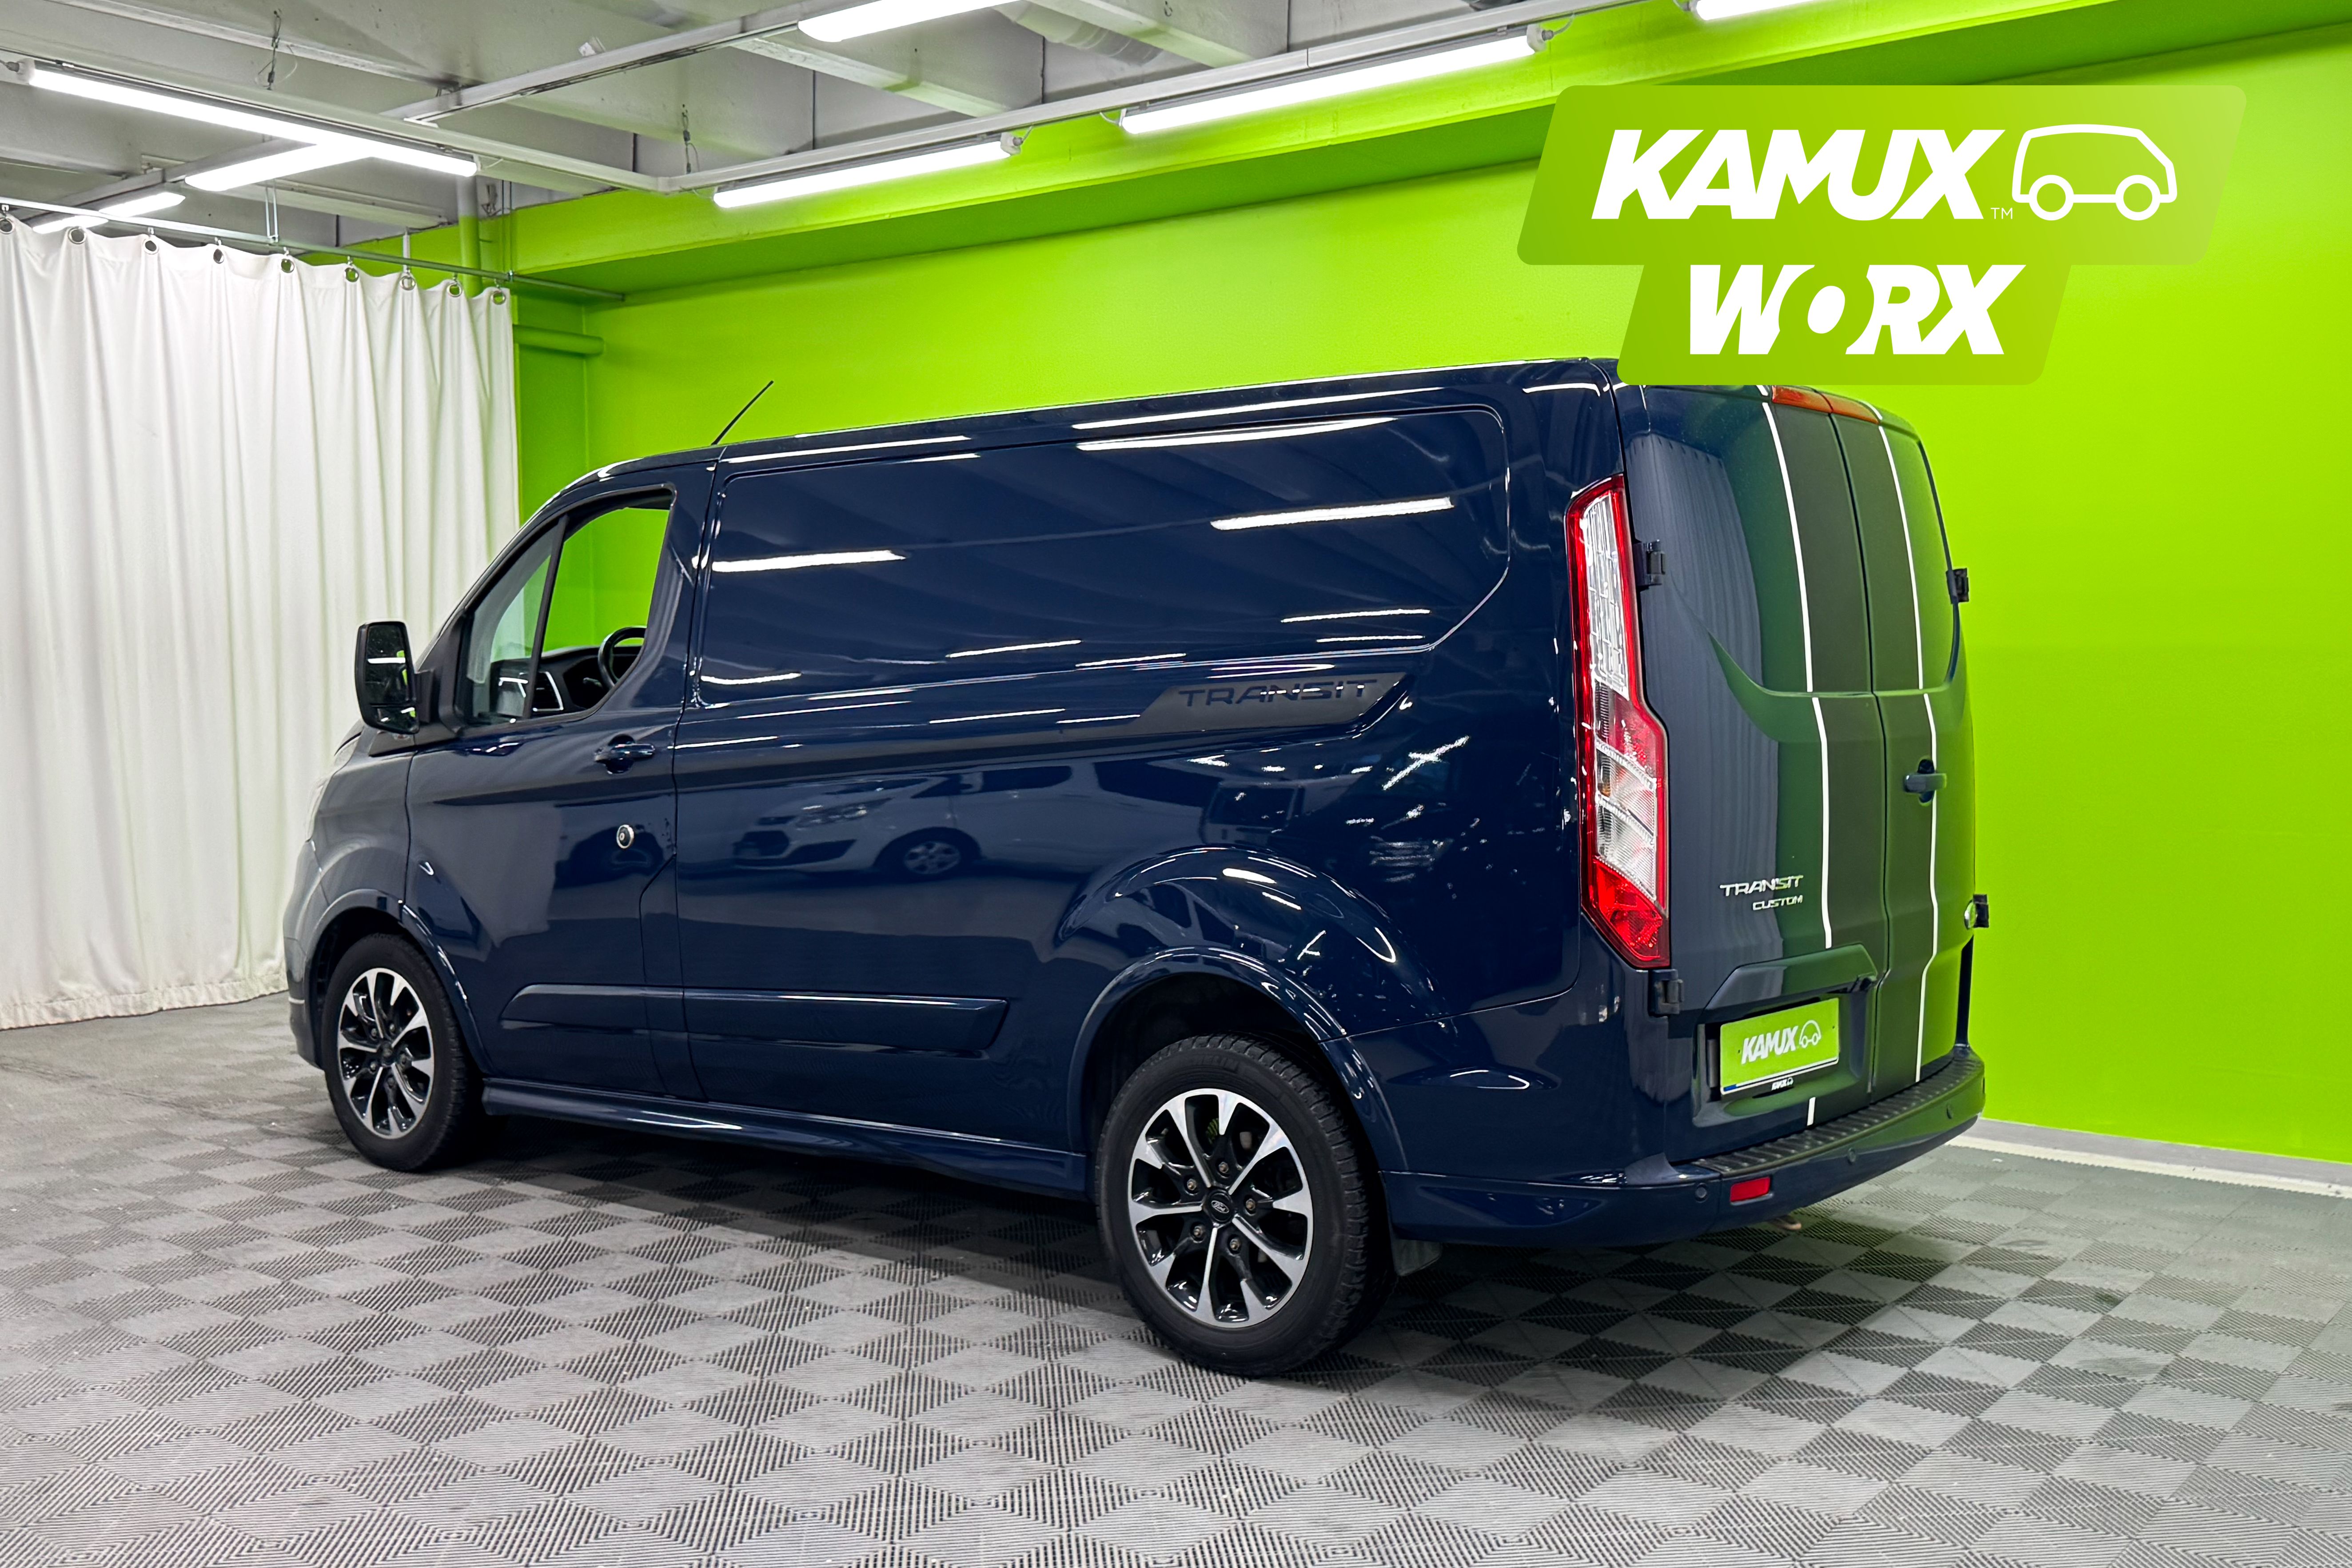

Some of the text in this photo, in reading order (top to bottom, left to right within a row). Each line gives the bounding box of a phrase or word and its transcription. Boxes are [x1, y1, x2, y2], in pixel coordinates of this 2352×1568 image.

[1178, 678, 1377, 707] TRANSIT
[1720, 875, 1804, 897] TRANSIT
[1752, 895, 1803, 910] CUSTOM
[1741, 1025, 1799, 1065] KAMUX
